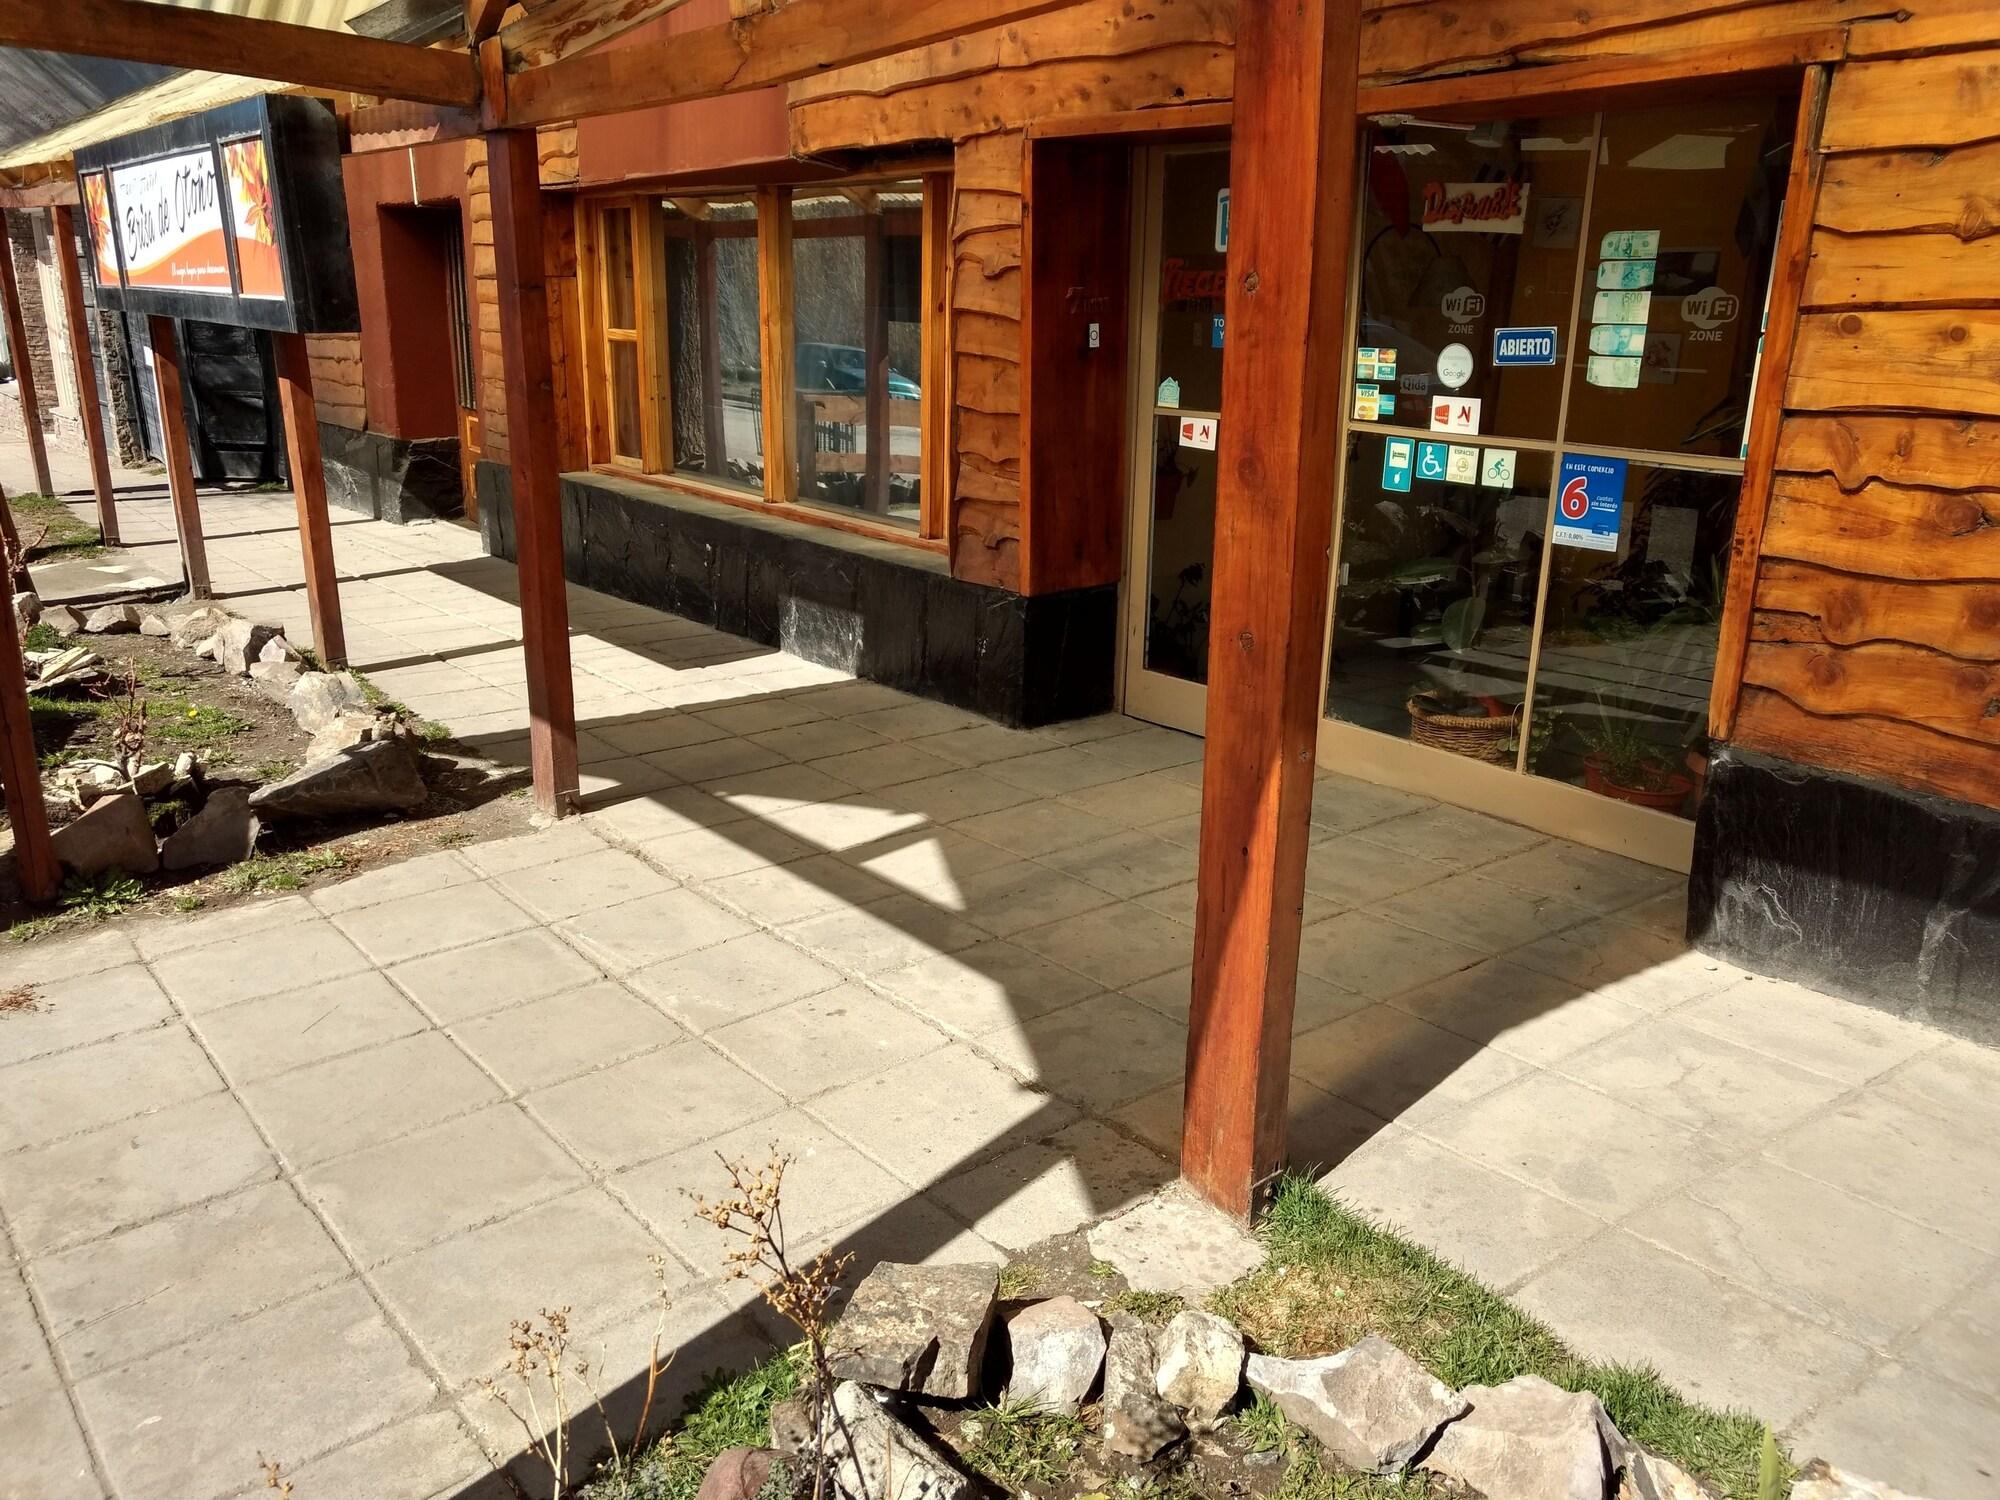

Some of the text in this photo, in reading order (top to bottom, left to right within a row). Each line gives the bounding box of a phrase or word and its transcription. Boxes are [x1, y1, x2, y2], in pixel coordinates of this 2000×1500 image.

[126, 203, 156, 261] Brisa
[158, 186, 170, 238] de
[174, 157, 216, 233] Otoño
[1448, 324, 1474, 335] ZONE
[1688, 330, 1724, 342] ZONE
[1499, 337, 1551, 356] ABIERTO
[1443, 368, 1466, 380] Google
[1565, 462, 1616, 475] EN ESTE COMERCIO
[1560, 475, 1589, 520] 6
[1596, 495, 1614, 503] cuotas
[1600, 500, 1618, 510] interés
